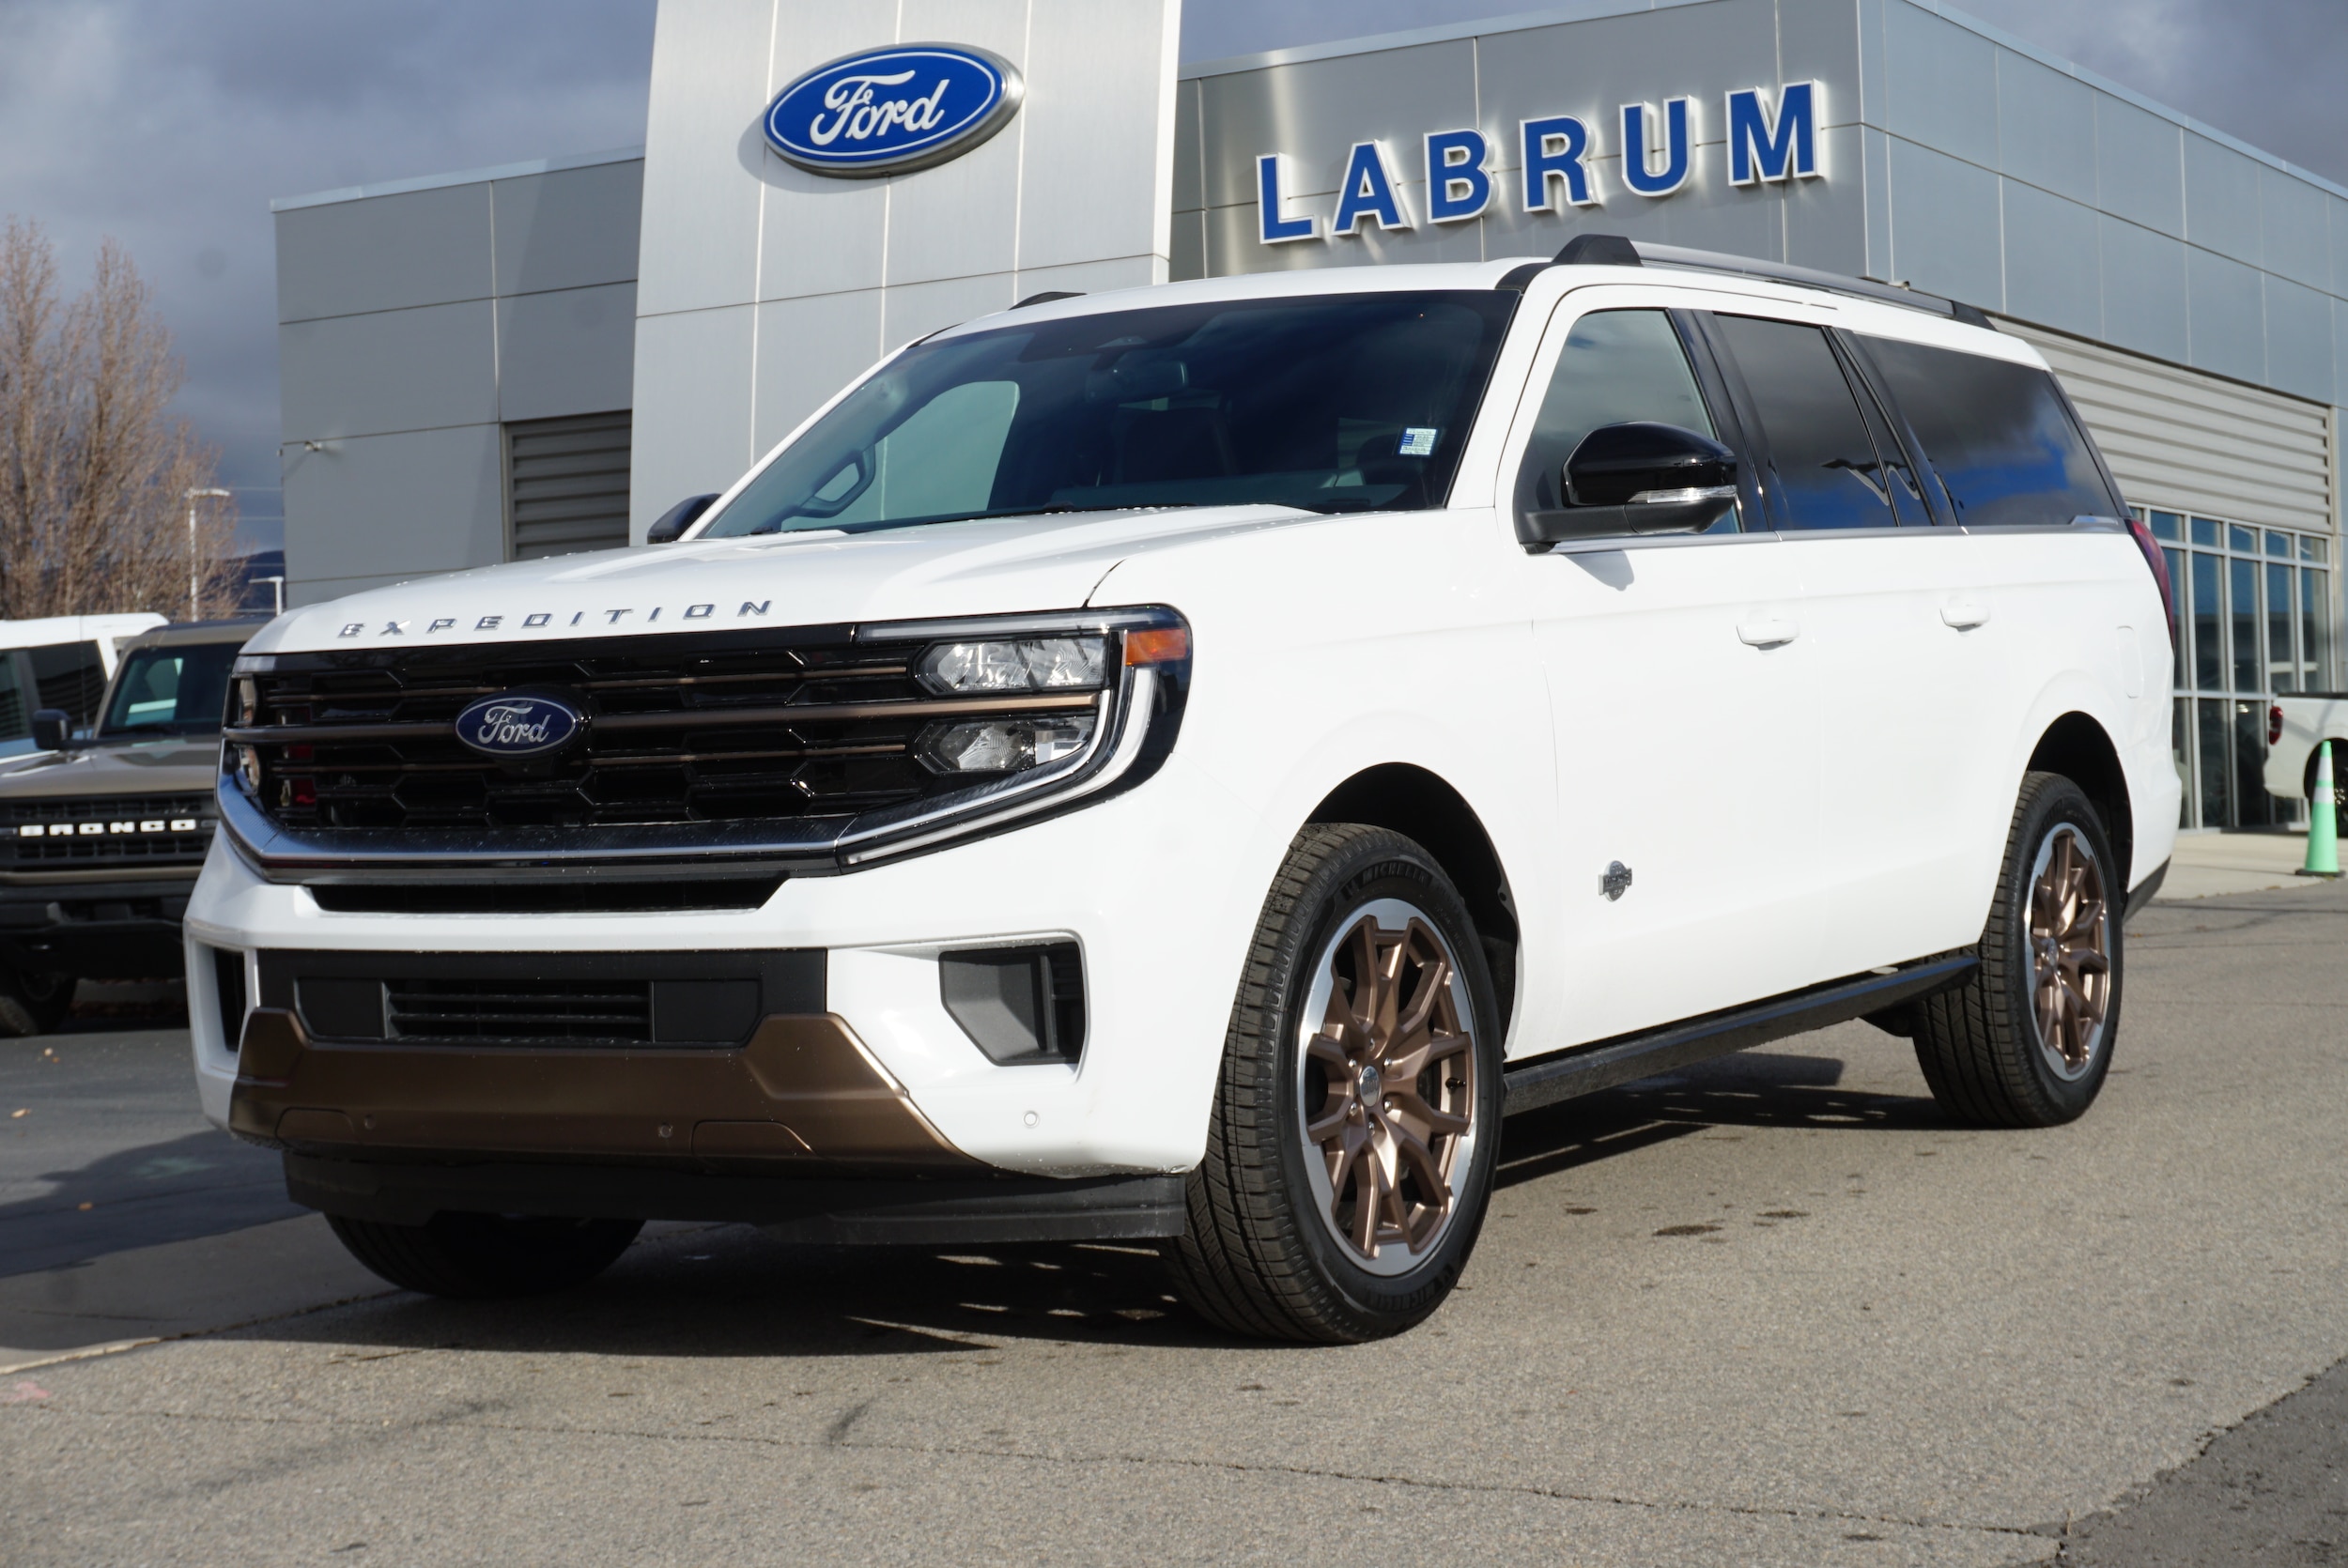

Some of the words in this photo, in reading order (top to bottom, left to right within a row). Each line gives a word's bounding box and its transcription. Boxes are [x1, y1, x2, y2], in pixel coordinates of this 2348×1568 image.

[810, 69, 950, 146] Ford
[1256, 79, 1823, 244] LABRUM
[337, 599, 773, 638] EXPEDITION
[477, 705, 552, 745] Ford
[20, 819, 196, 837] BRONCO
[1362, 861, 1429, 886] MICHELIN
